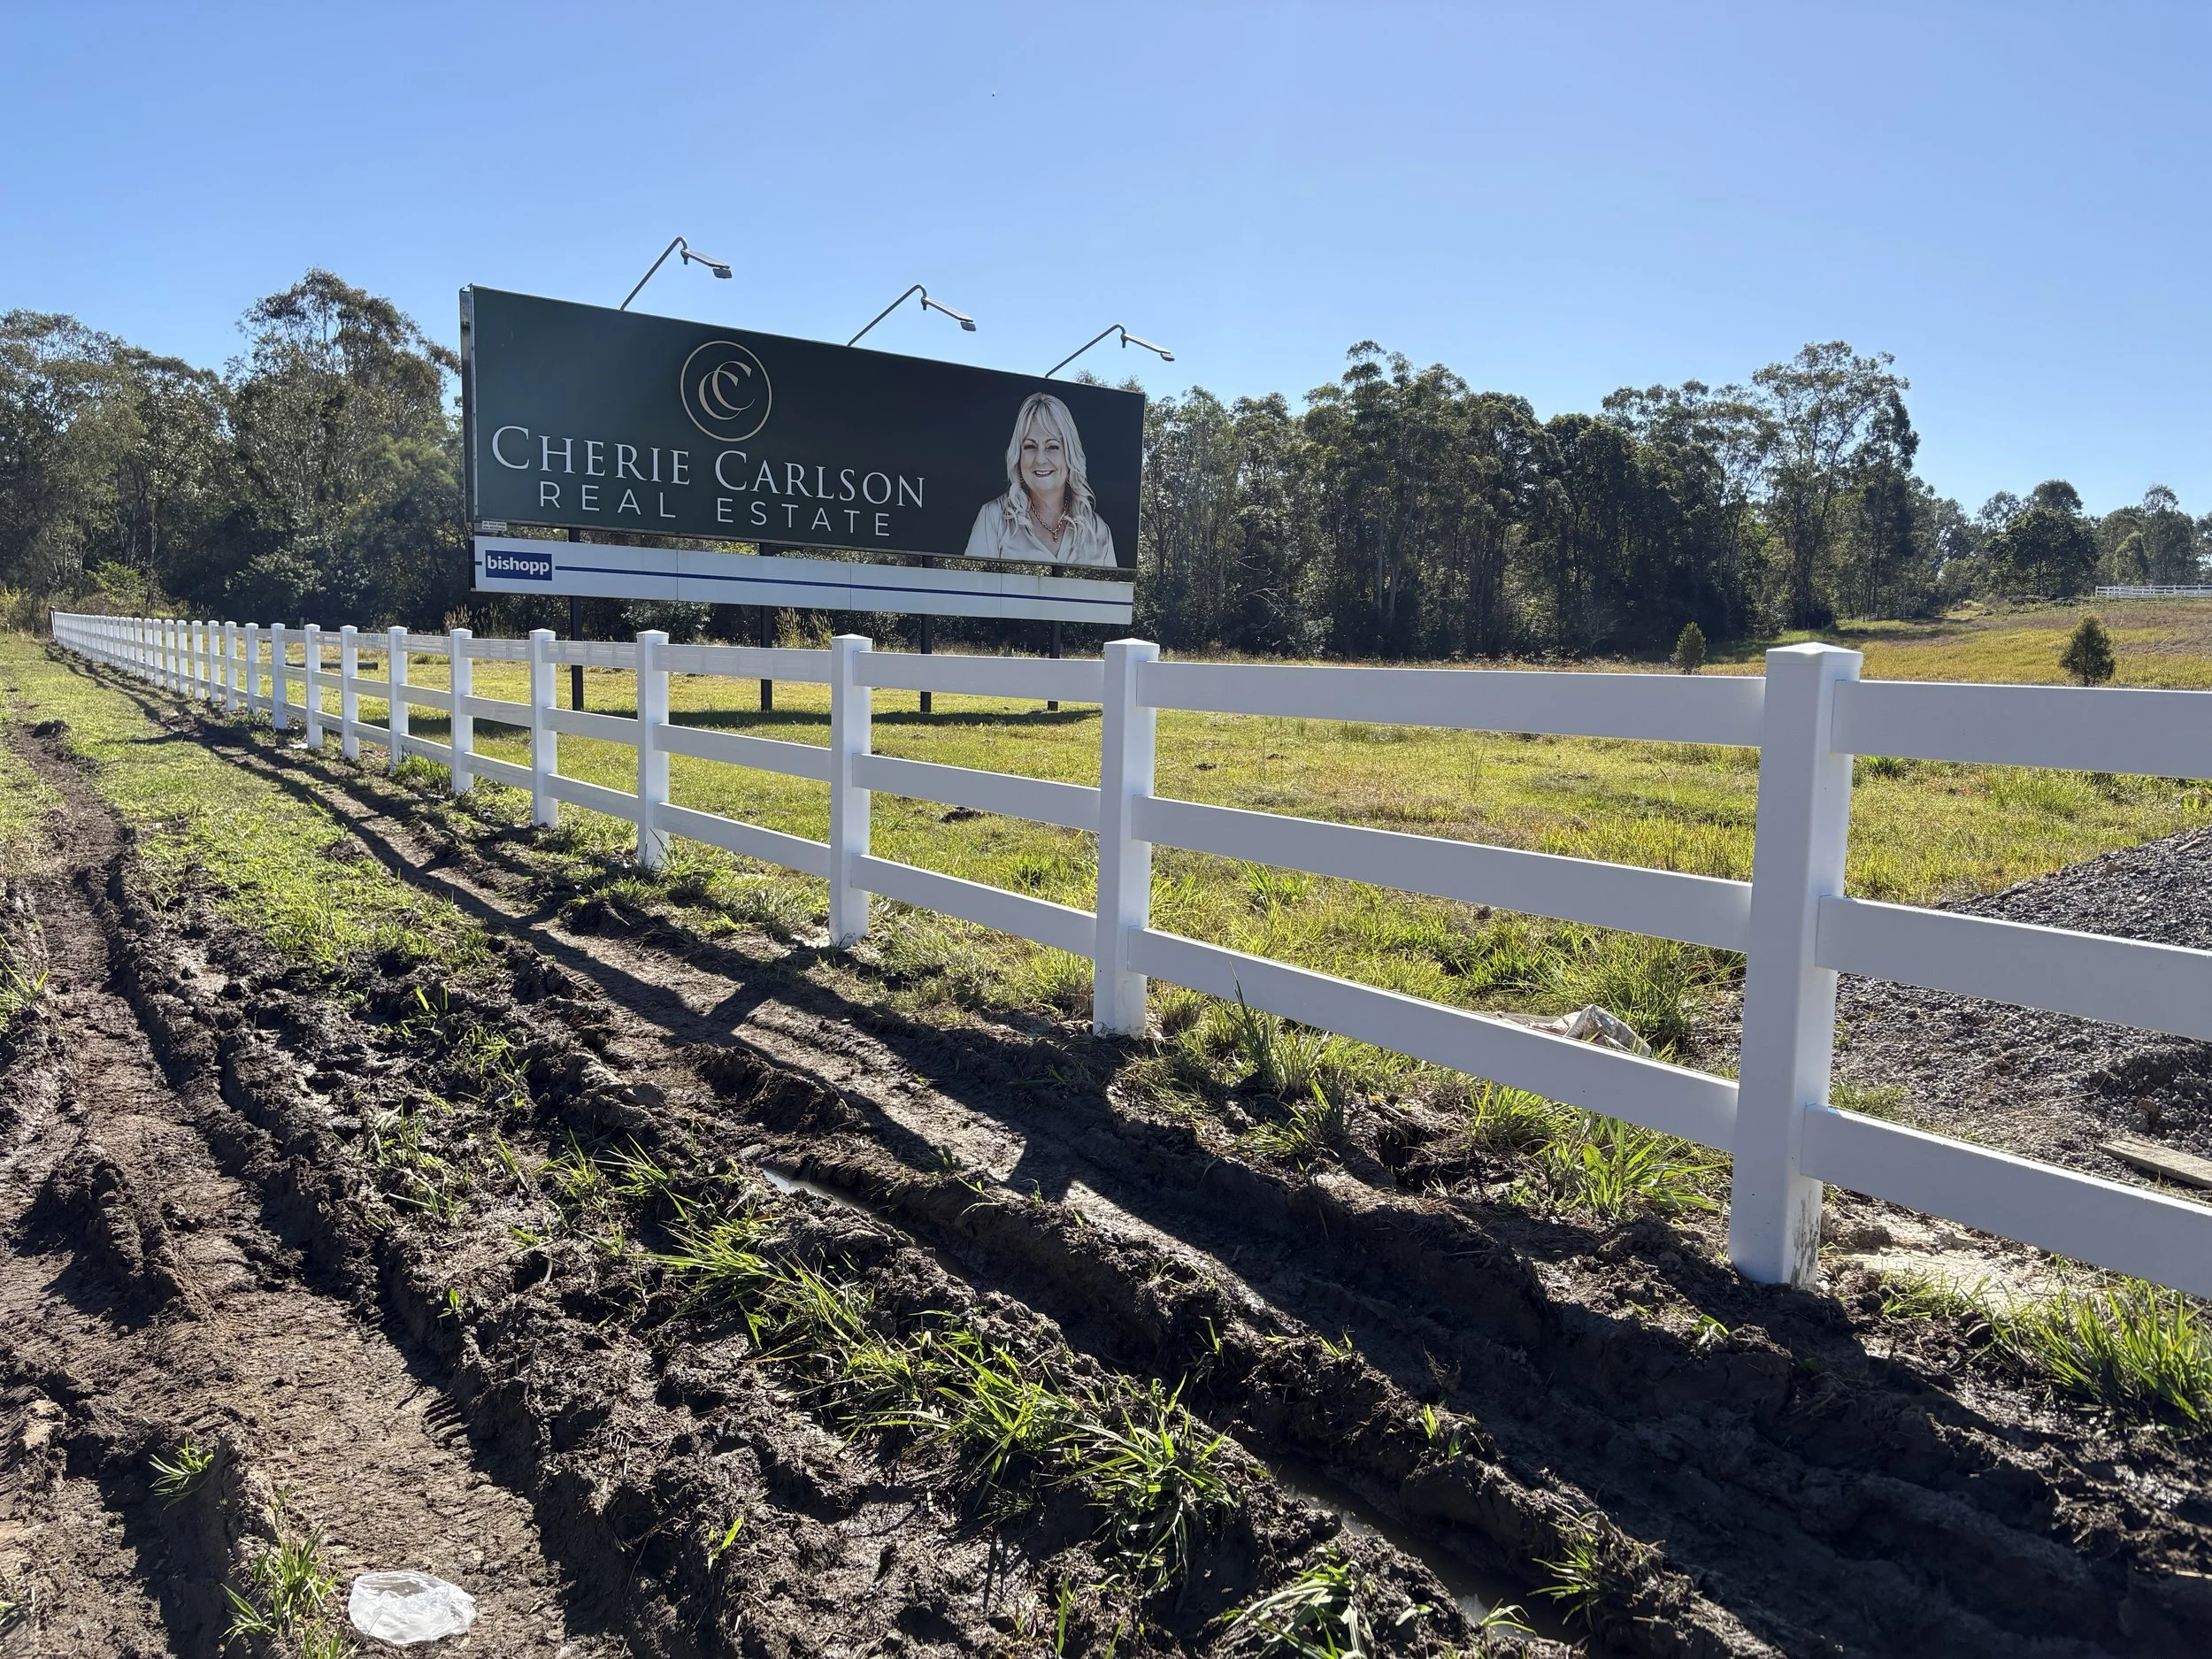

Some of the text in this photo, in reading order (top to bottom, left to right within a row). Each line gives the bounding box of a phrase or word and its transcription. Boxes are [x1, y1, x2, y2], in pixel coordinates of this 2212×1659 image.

[492, 426, 926, 508] CHERIE CARLSON
[540, 480, 890, 537] REAL ESTATE
[487, 555, 549, 575] bishopp
